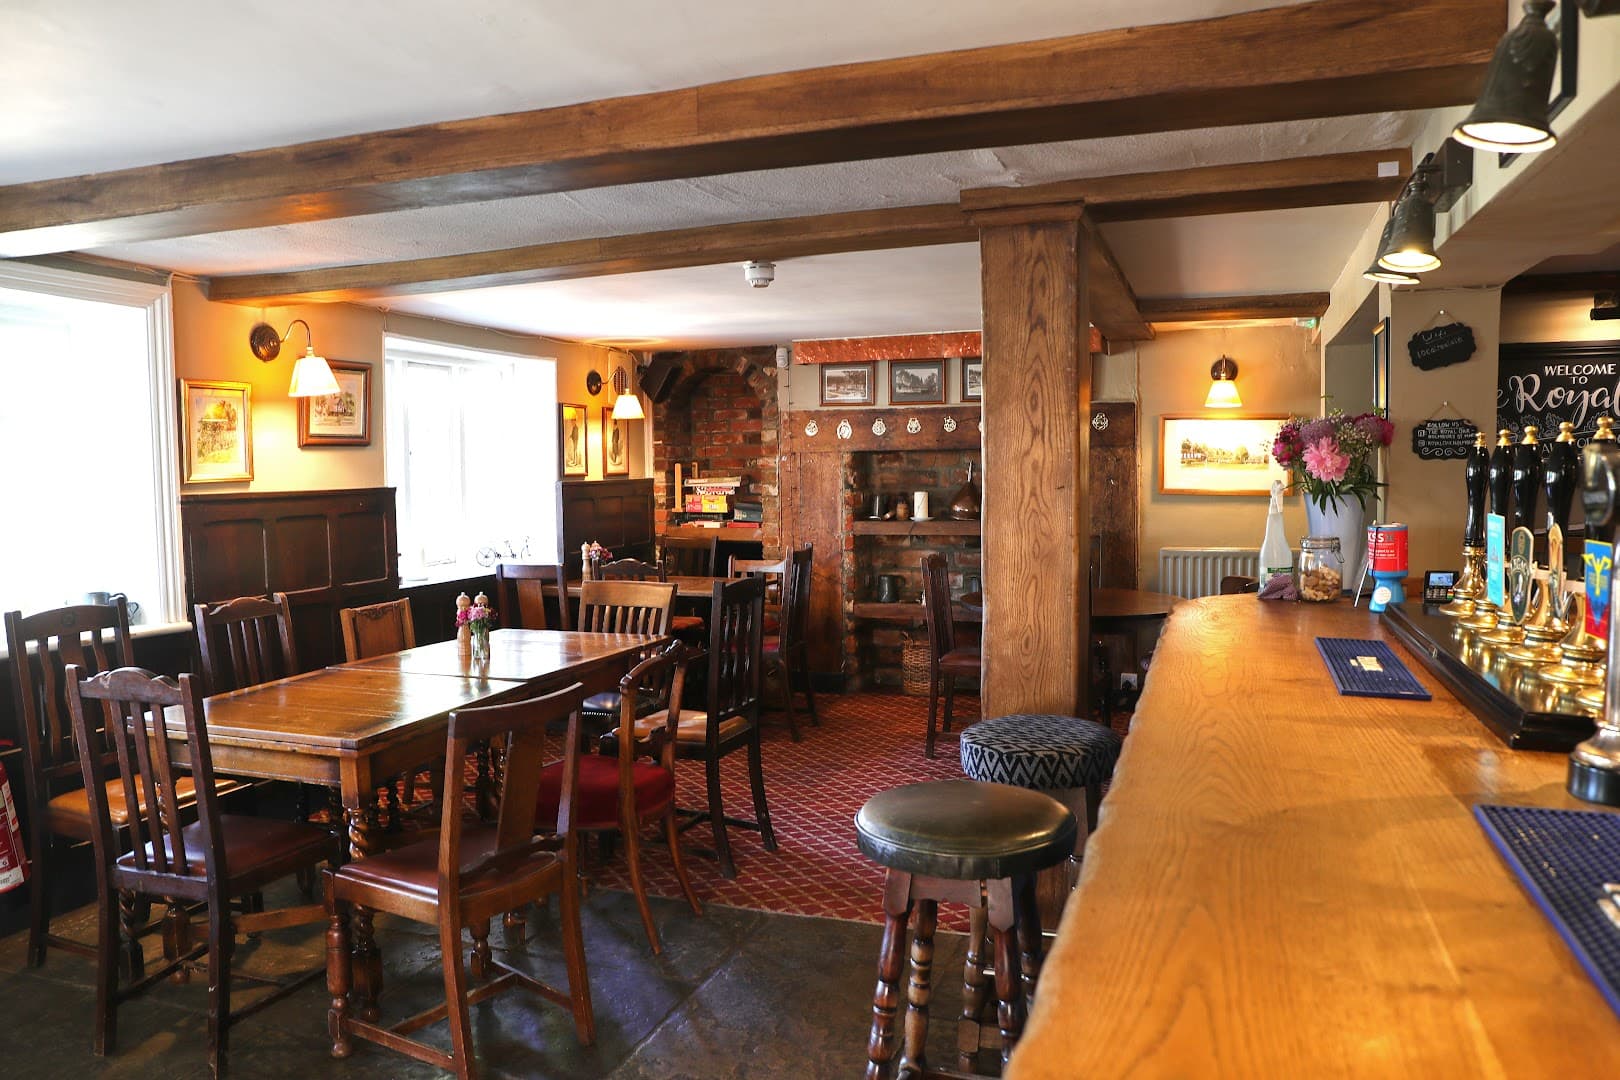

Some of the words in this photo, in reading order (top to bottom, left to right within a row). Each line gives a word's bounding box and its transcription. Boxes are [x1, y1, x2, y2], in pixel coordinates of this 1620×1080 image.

[1544, 363, 1617, 376] WELCOME
[1570, 376, 1588, 385] TO
[1508, 373, 1620, 429] Royal
